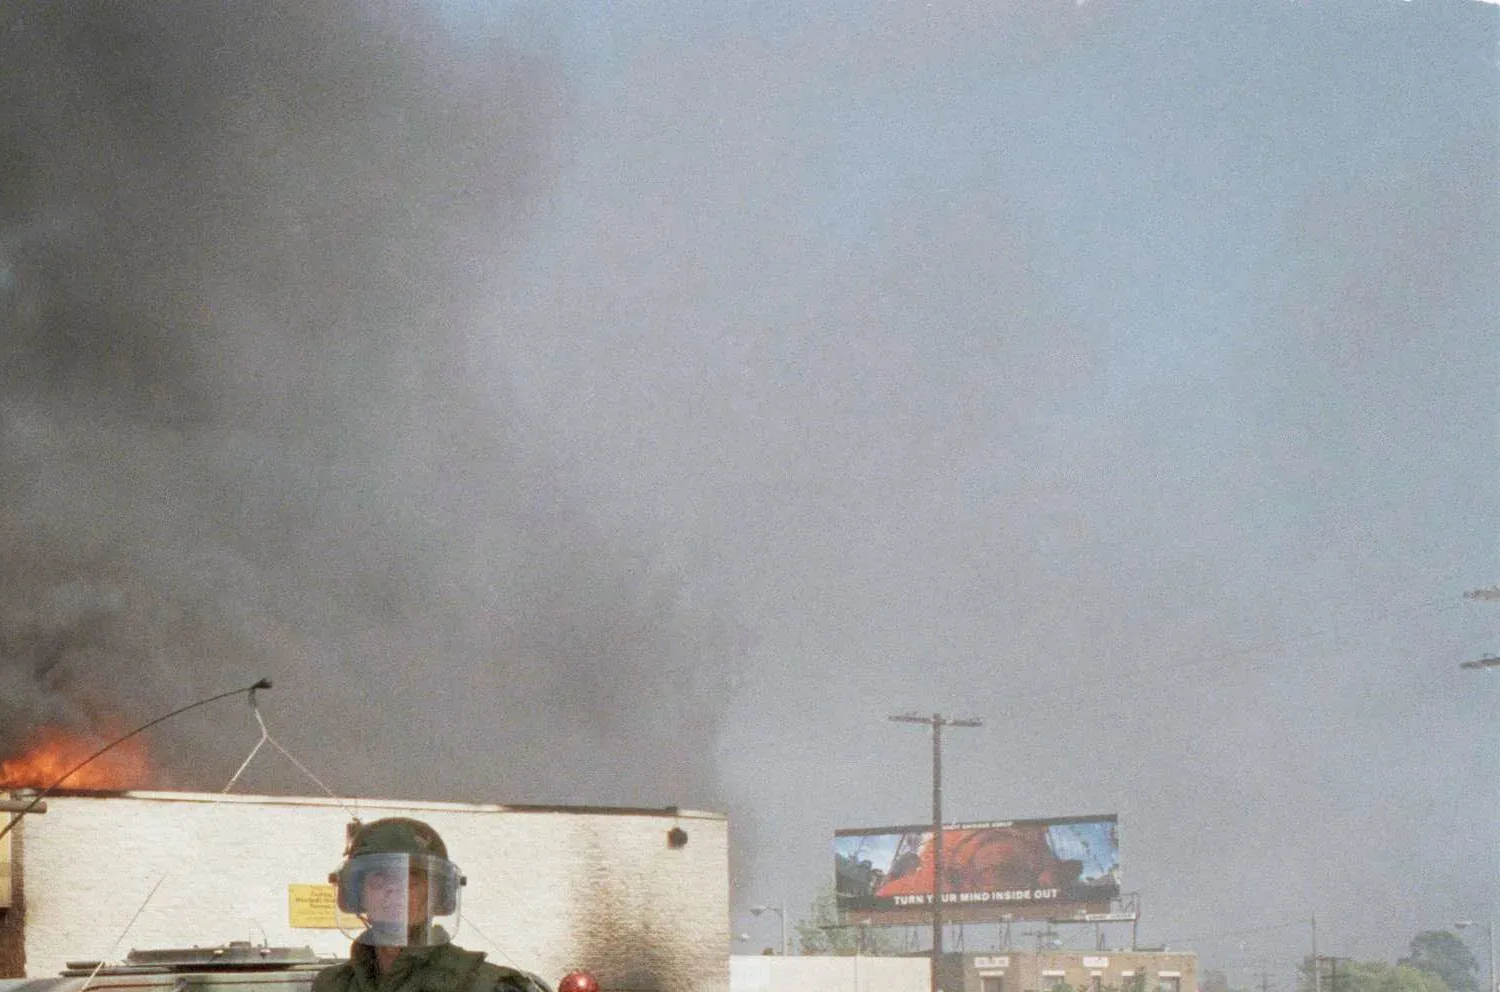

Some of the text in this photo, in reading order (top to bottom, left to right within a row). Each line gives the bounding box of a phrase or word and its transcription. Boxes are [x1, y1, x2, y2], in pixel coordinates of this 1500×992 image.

[893, 889, 1058, 905] TURN YUR MIND INSIDE OUT
